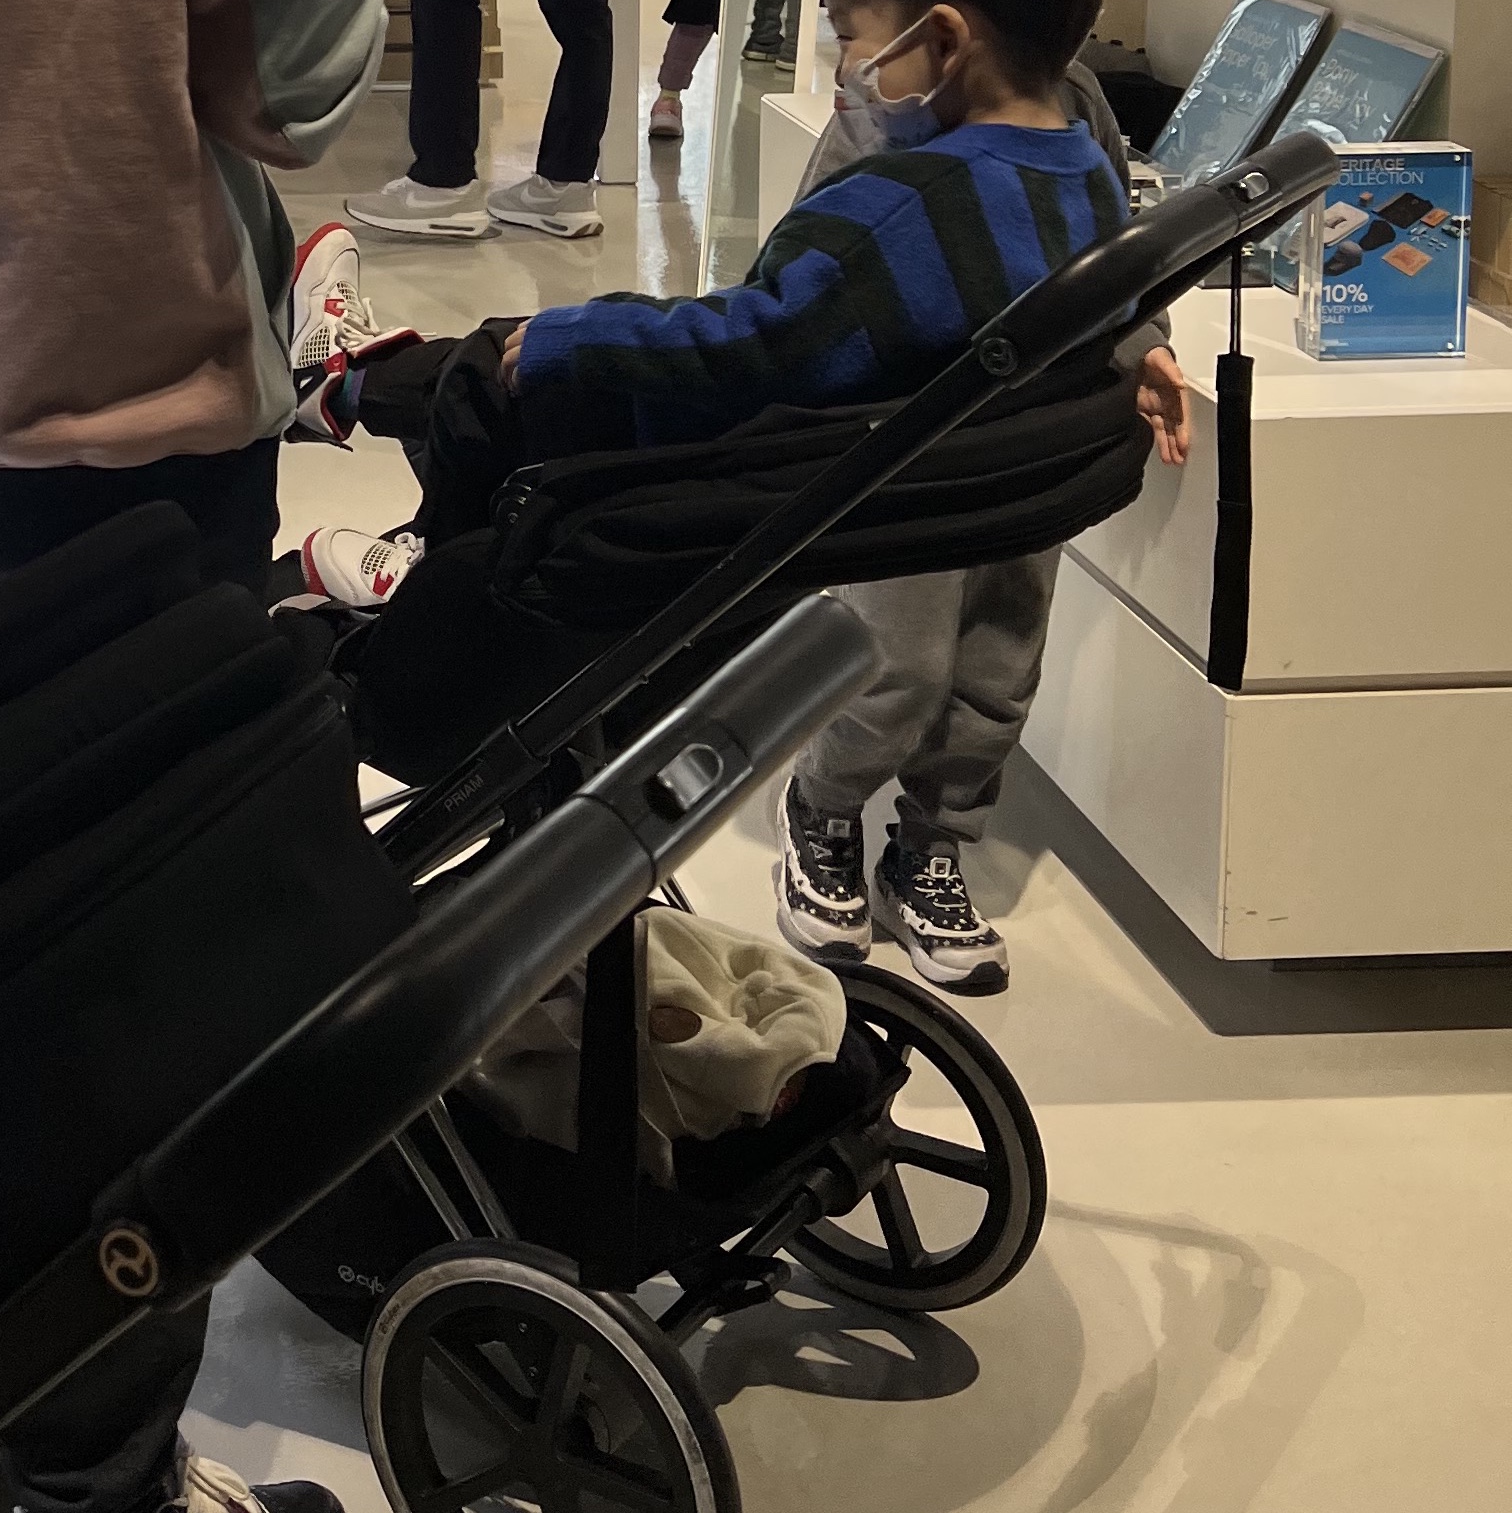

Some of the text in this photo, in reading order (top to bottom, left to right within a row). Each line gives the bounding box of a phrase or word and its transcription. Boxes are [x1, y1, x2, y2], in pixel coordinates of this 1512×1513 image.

[1322, 284, 1369, 304] 10%
[1321, 304, 1374, 315] EVERY DAY
[1321, 315, 1346, 325] SALE
[443, 773, 485, 813] PRIAM
